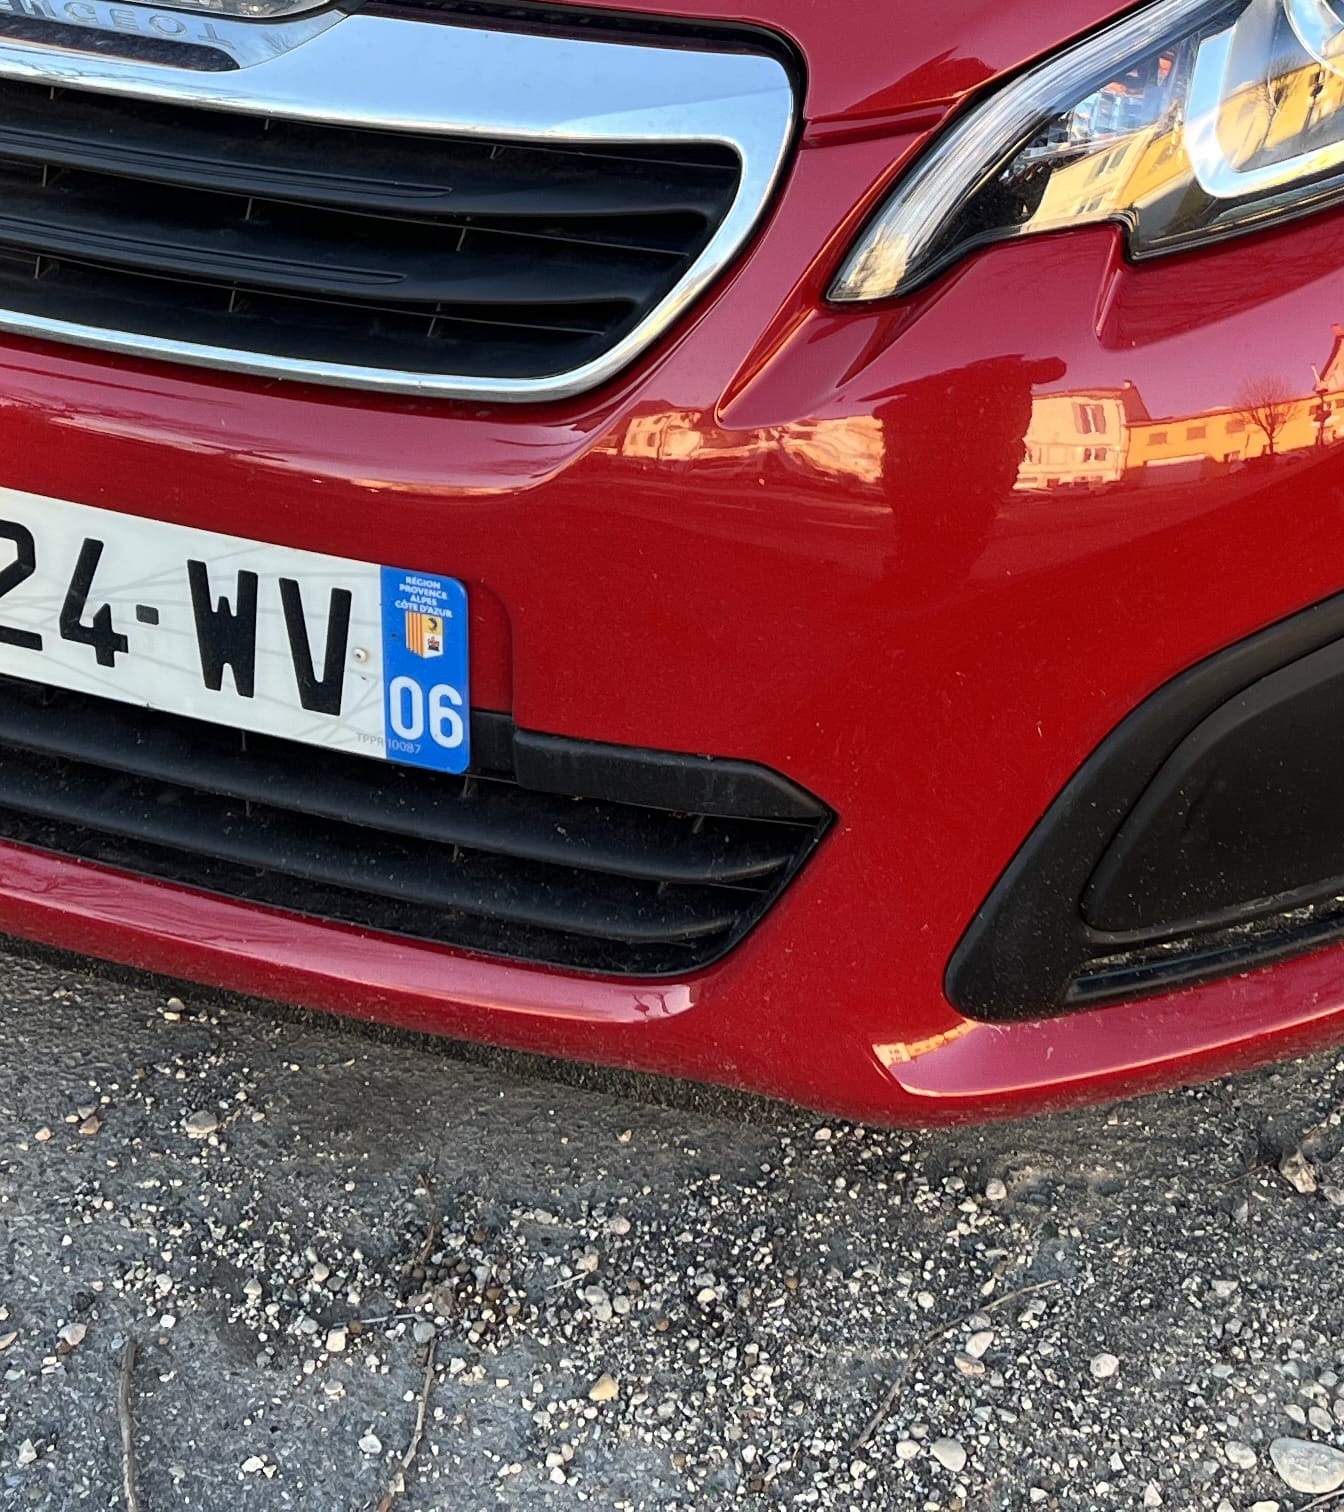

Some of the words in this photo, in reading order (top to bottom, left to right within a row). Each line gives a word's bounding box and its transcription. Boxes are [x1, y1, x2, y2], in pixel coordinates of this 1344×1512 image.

[399, 583, 447, 600] PROVENCE
[409, 594, 438, 606] ALPES
[395, 600, 418, 611] CÔTE
[419, 605, 453, 618] D'AZUR
[389, 675, 464, 749] 06
[357, 732, 385, 749] TPPR
[387, 737, 422, 754] 10087
